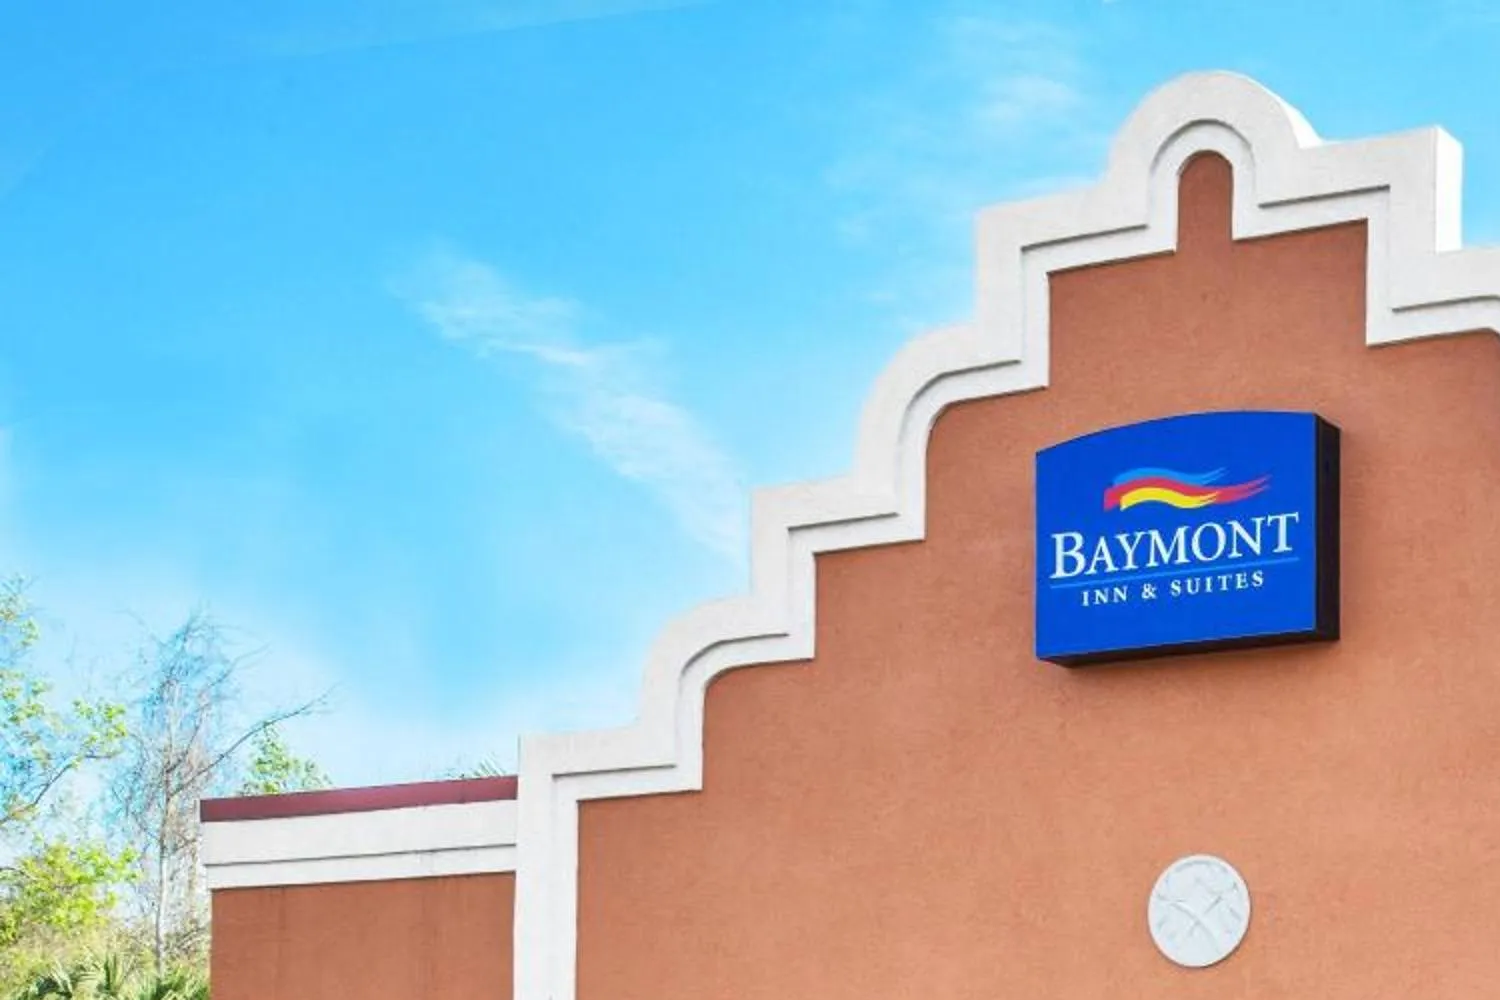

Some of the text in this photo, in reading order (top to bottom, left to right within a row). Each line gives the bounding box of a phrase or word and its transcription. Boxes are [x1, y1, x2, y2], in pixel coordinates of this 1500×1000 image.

[1050, 511, 1299, 579] BAYMONT
[1082, 570, 1264, 606] INN & SUITES
